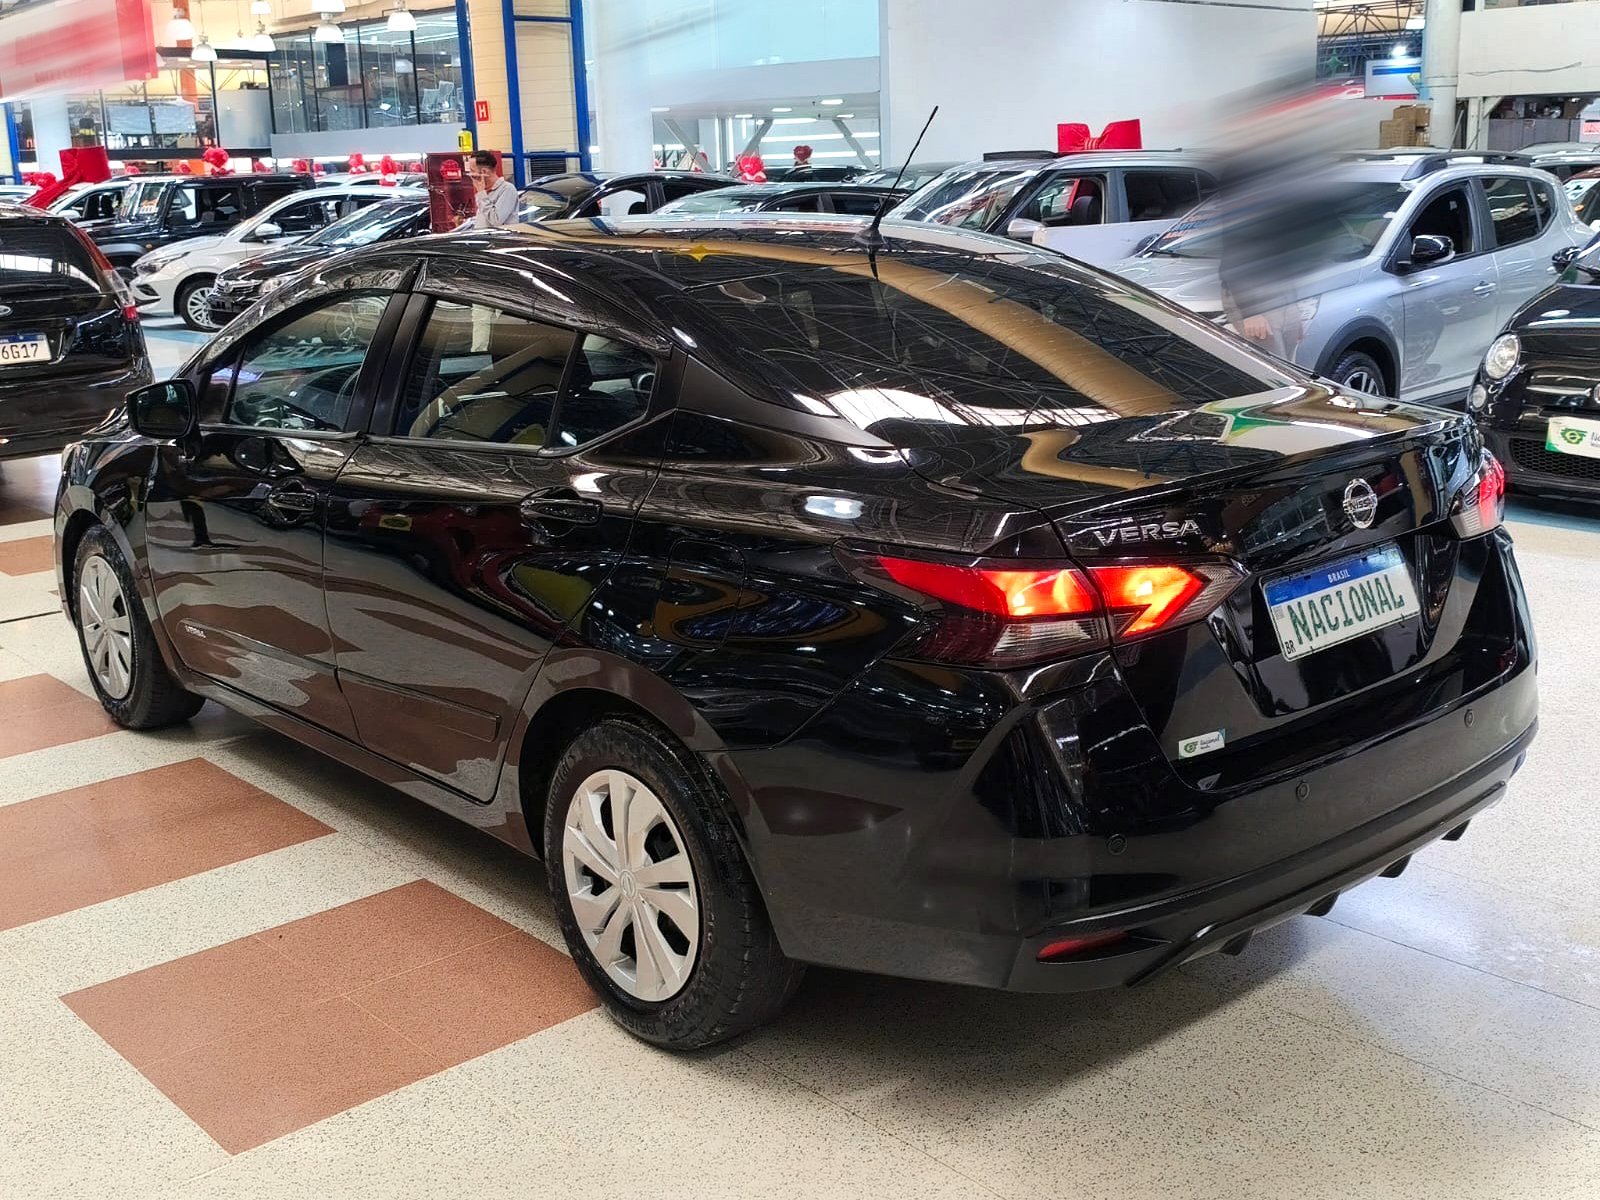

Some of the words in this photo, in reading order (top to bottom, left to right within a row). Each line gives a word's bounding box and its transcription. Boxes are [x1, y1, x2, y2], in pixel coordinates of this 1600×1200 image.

[1, 343, 38, 360] 6G17
[1093, 519, 1203, 547] VERSA
[1327, 569, 1351, 584] BRASIL
[1287, 574, 1405, 645] NACIONAL
[1284, 640, 1297, 655] BR
